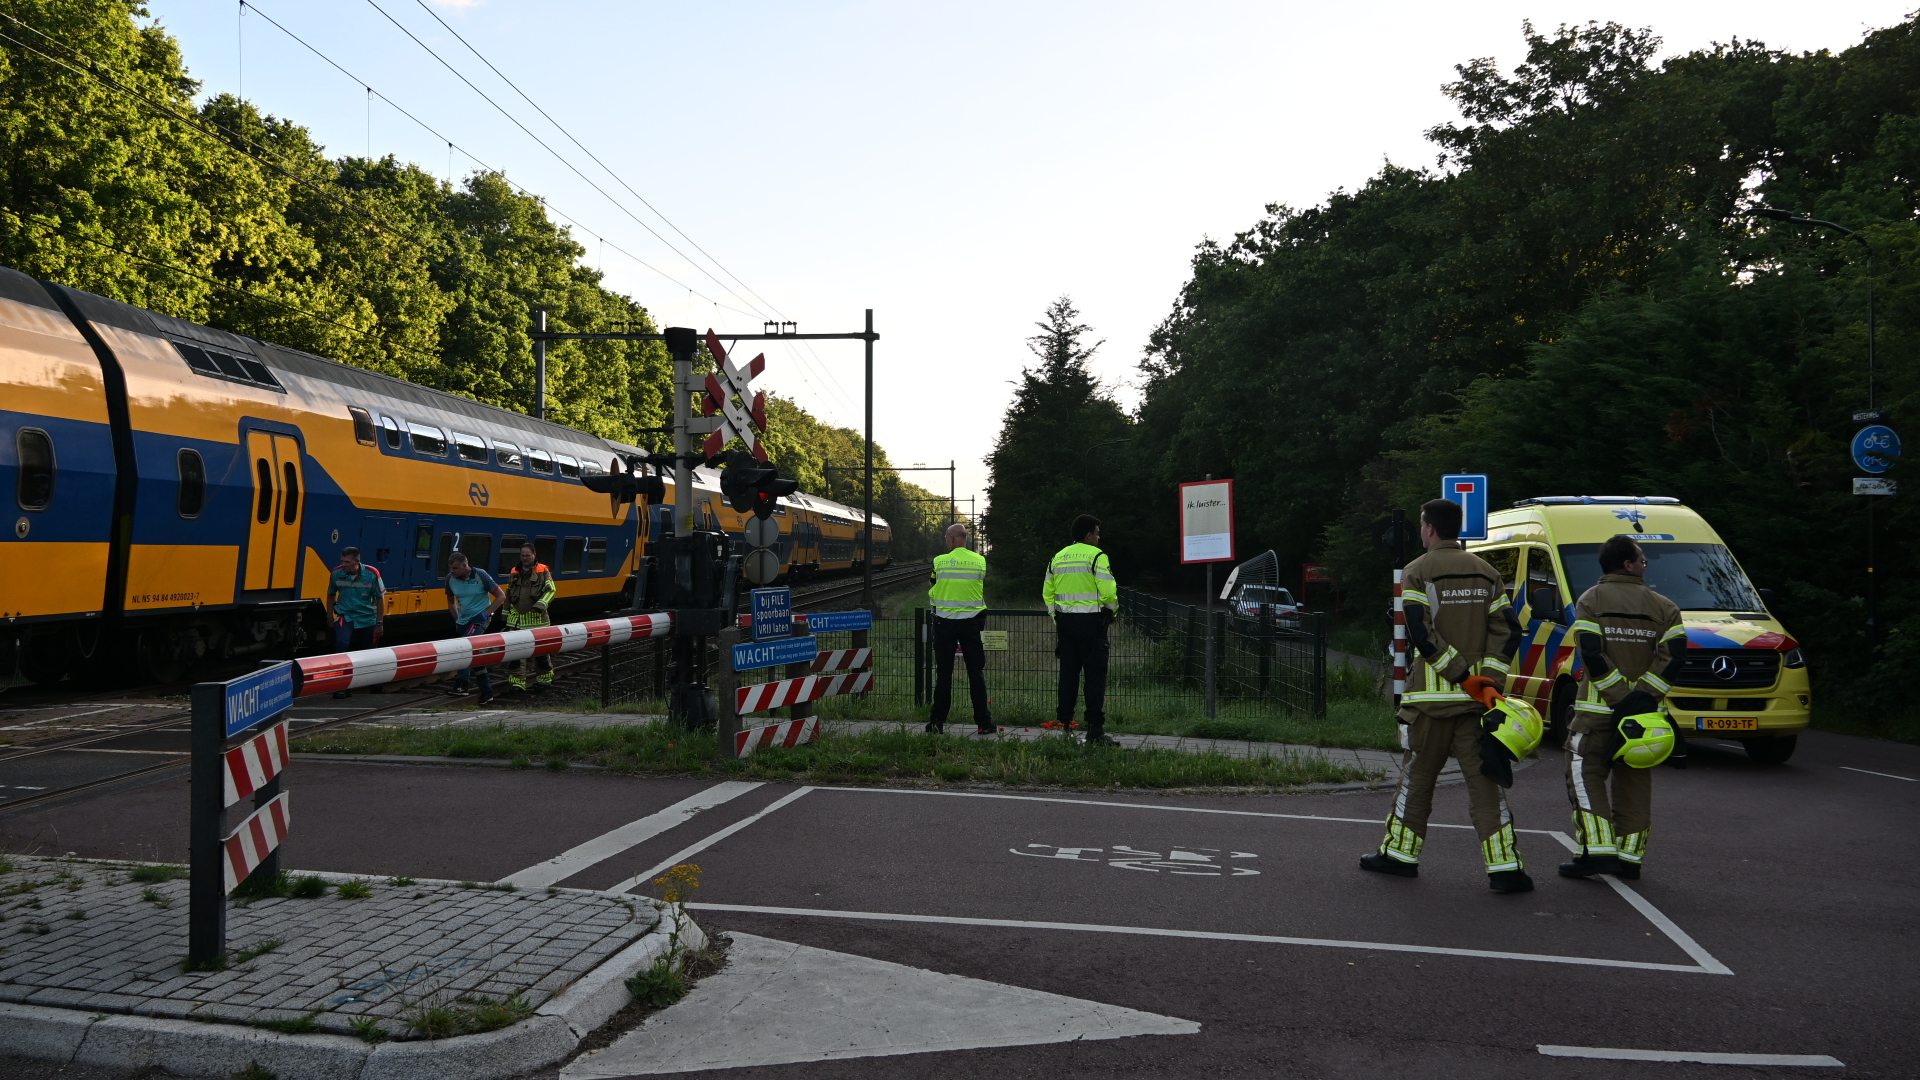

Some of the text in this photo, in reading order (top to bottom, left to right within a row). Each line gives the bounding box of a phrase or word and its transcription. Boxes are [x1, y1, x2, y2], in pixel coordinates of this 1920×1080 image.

[1187, 501, 1195, 509] ik
[453, 532, 460, 551] 2
[584, 537, 589, 551] 2
[132, 595, 140, 603] NL
[142, 594, 150, 603] NS
[152, 594, 160, 602] 94
[761, 594, 785, 608] bij FILE
[756, 608, 790, 620] spoorbaan
[758, 622, 789, 635] VRIJ laten
[805, 617, 830, 629] ACHT
[1604, 627, 1657, 638] BRANDWEER
[736, 646, 776, 665] WACHT
[228, 686, 260, 725] WACHT
[1707, 719, 1754, 729] R-093-TF
